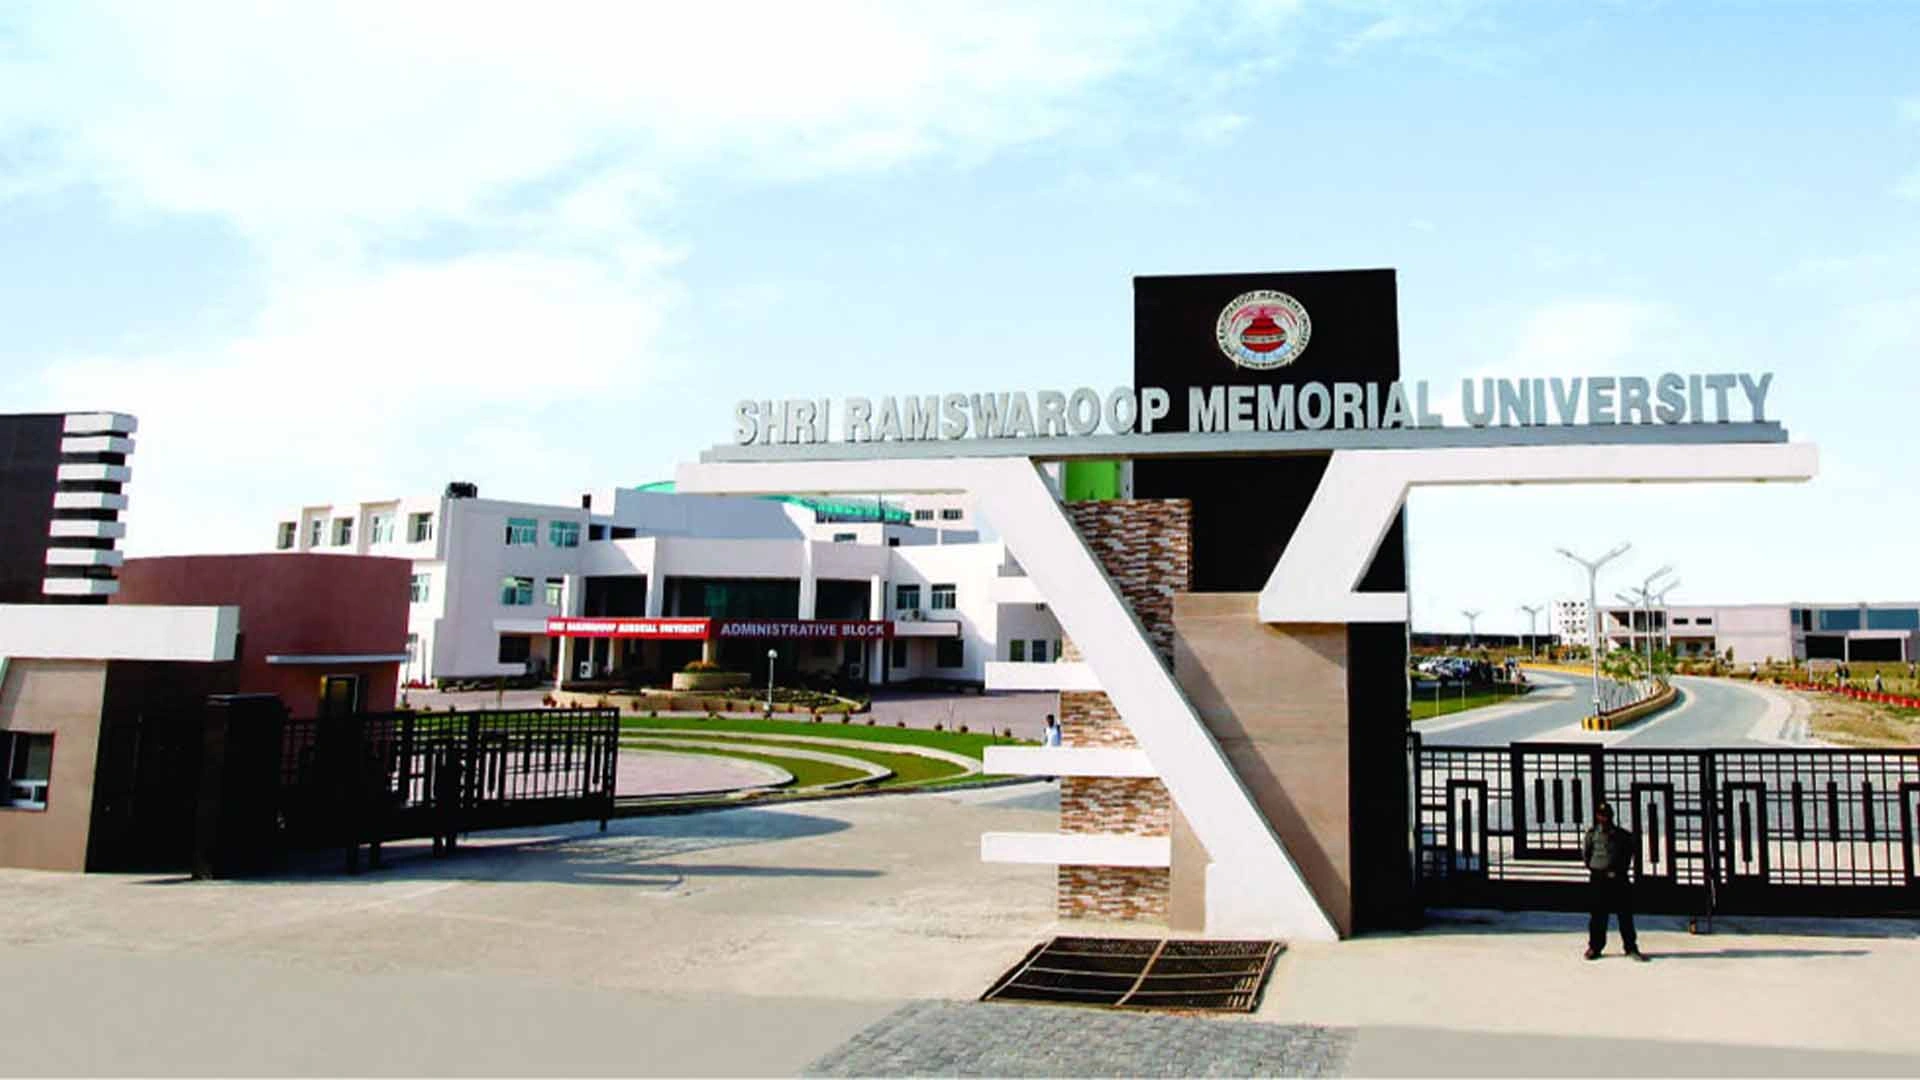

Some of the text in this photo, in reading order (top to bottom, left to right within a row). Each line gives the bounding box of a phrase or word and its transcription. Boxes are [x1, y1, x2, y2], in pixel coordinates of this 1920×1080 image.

[735, 373, 1774, 445] SHRI RAMSWAROOP MEMORIAL UNIVERSITY
[720, 623, 884, 636] ADMINISTRATIVE BLOCK
